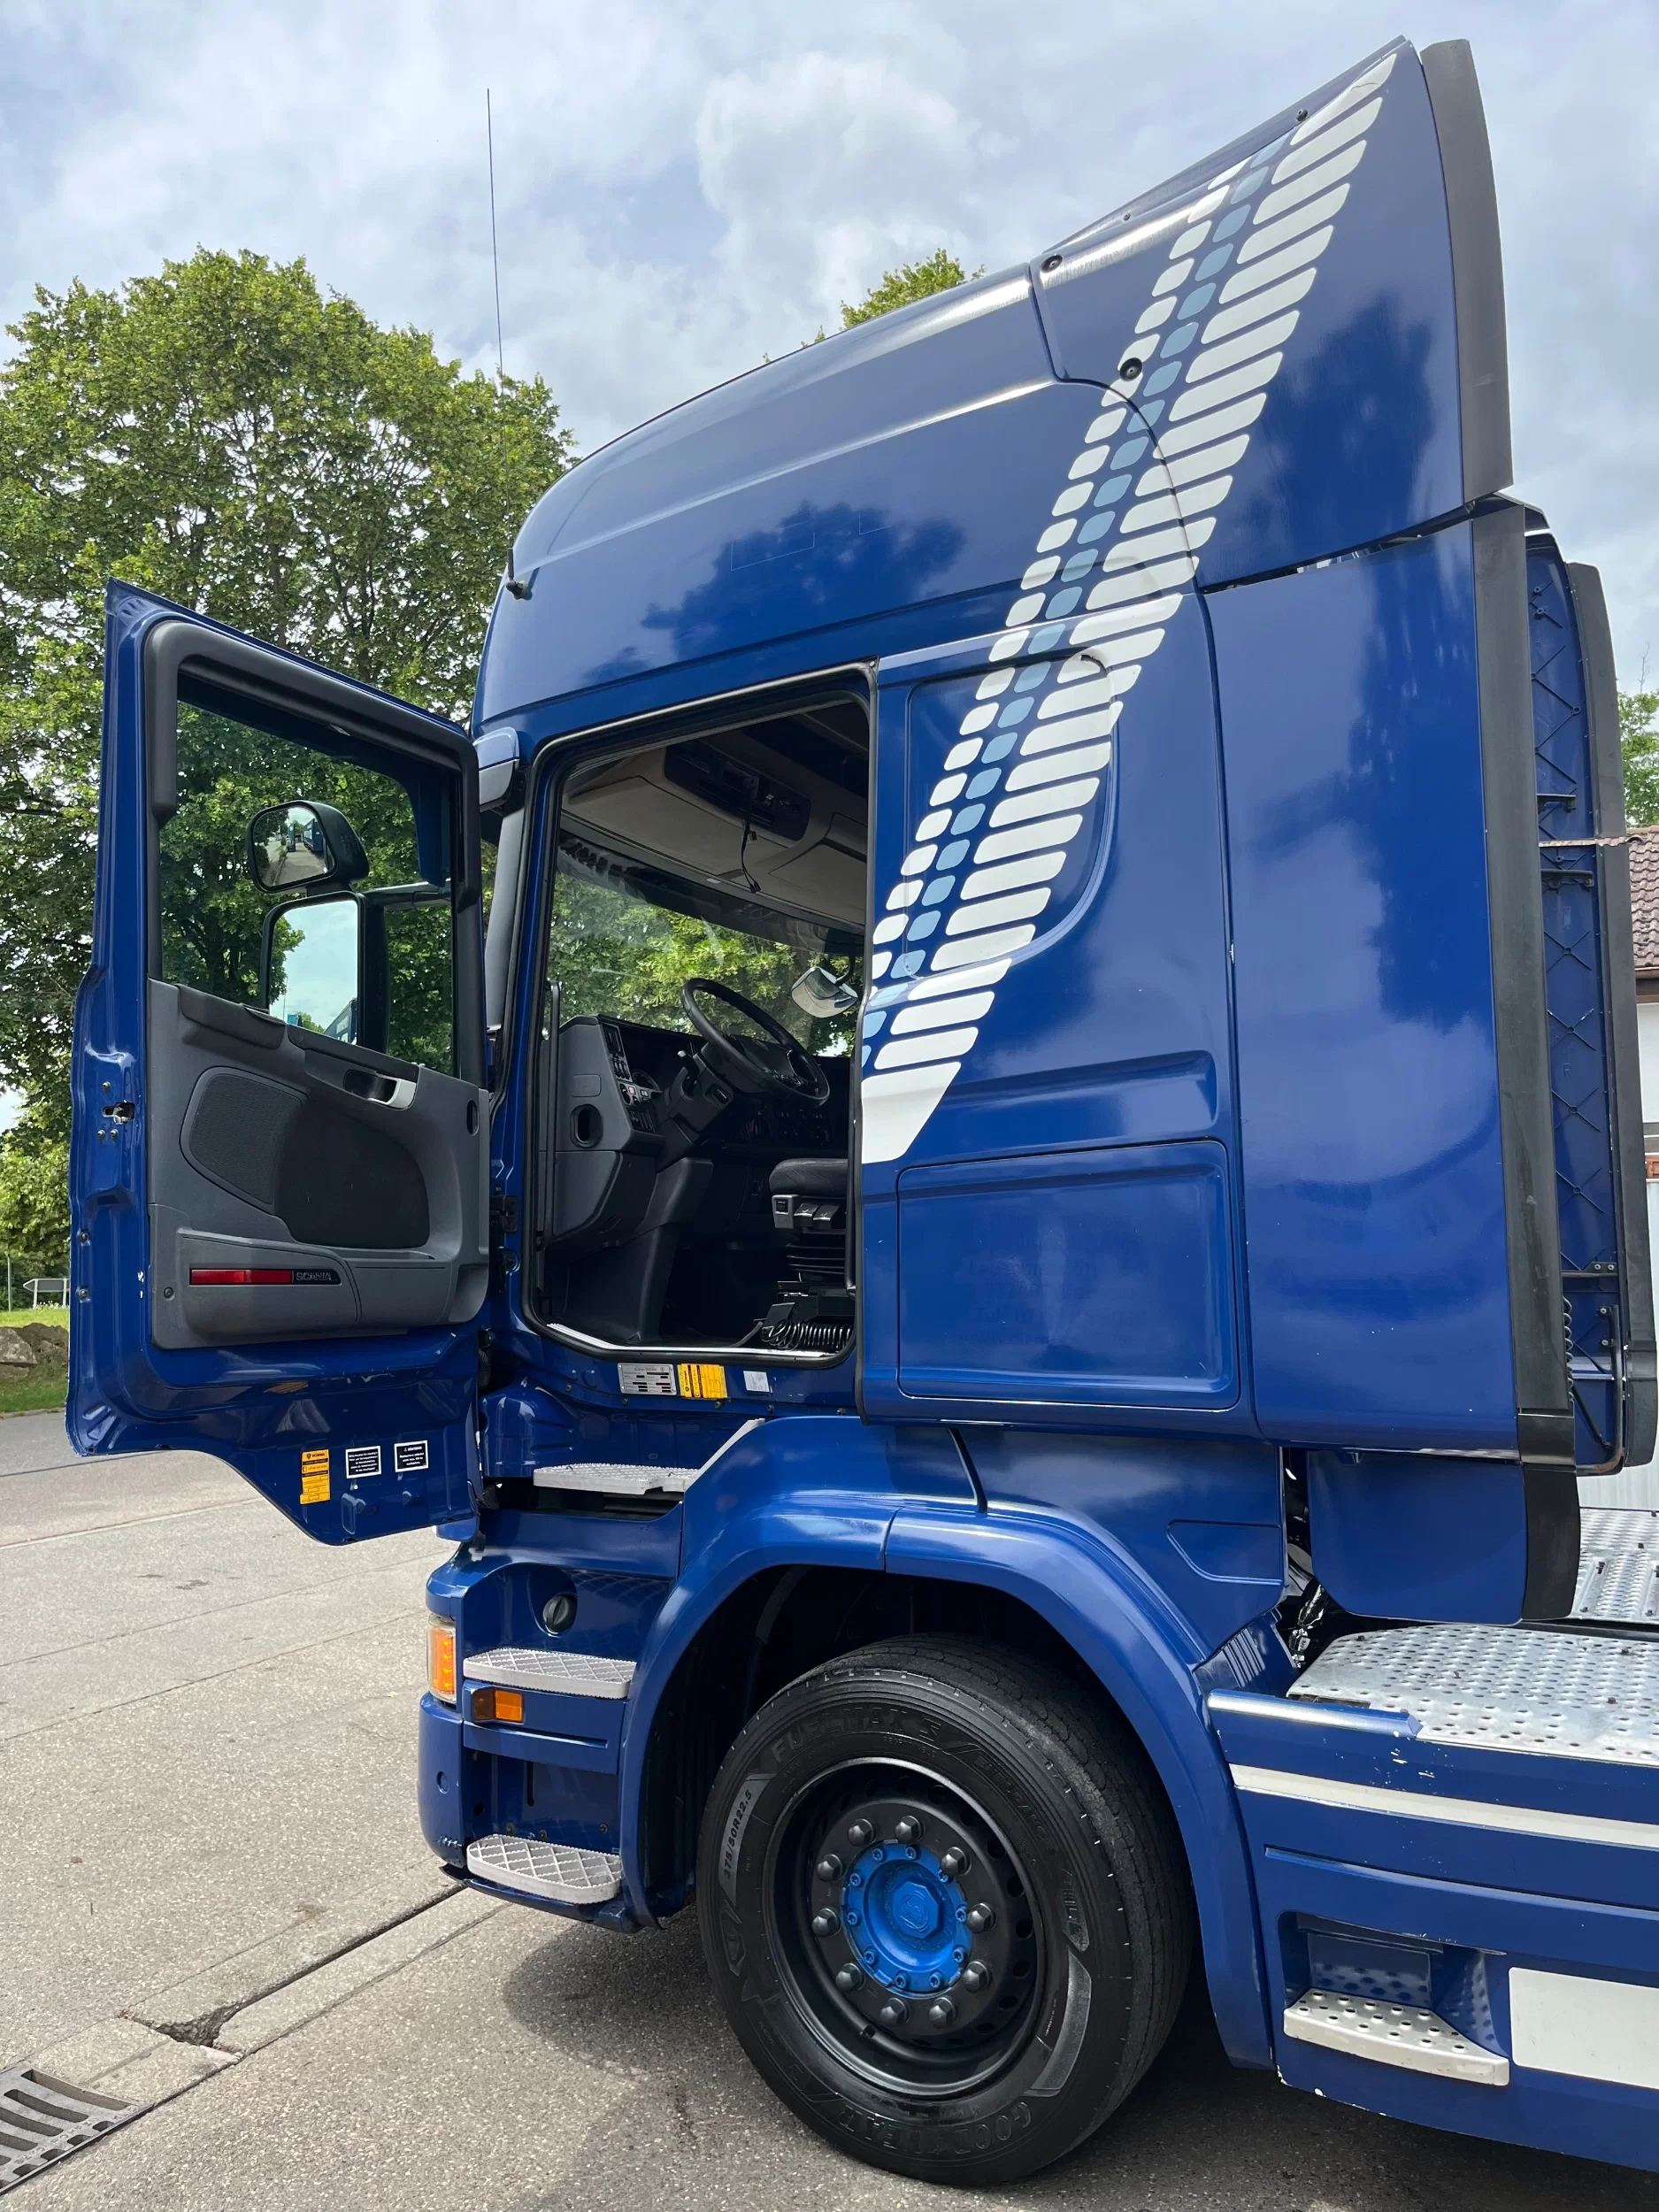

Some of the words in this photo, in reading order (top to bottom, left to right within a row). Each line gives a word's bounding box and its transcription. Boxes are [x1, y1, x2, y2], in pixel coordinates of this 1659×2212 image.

[296, 1271, 332, 1281] SCANIA
[771, 1706, 908, 1763] FUELMAX
[724, 1789, 753, 1880] 375/50R22.5
[838, 2102, 1032, 2155] GOODYEAR
